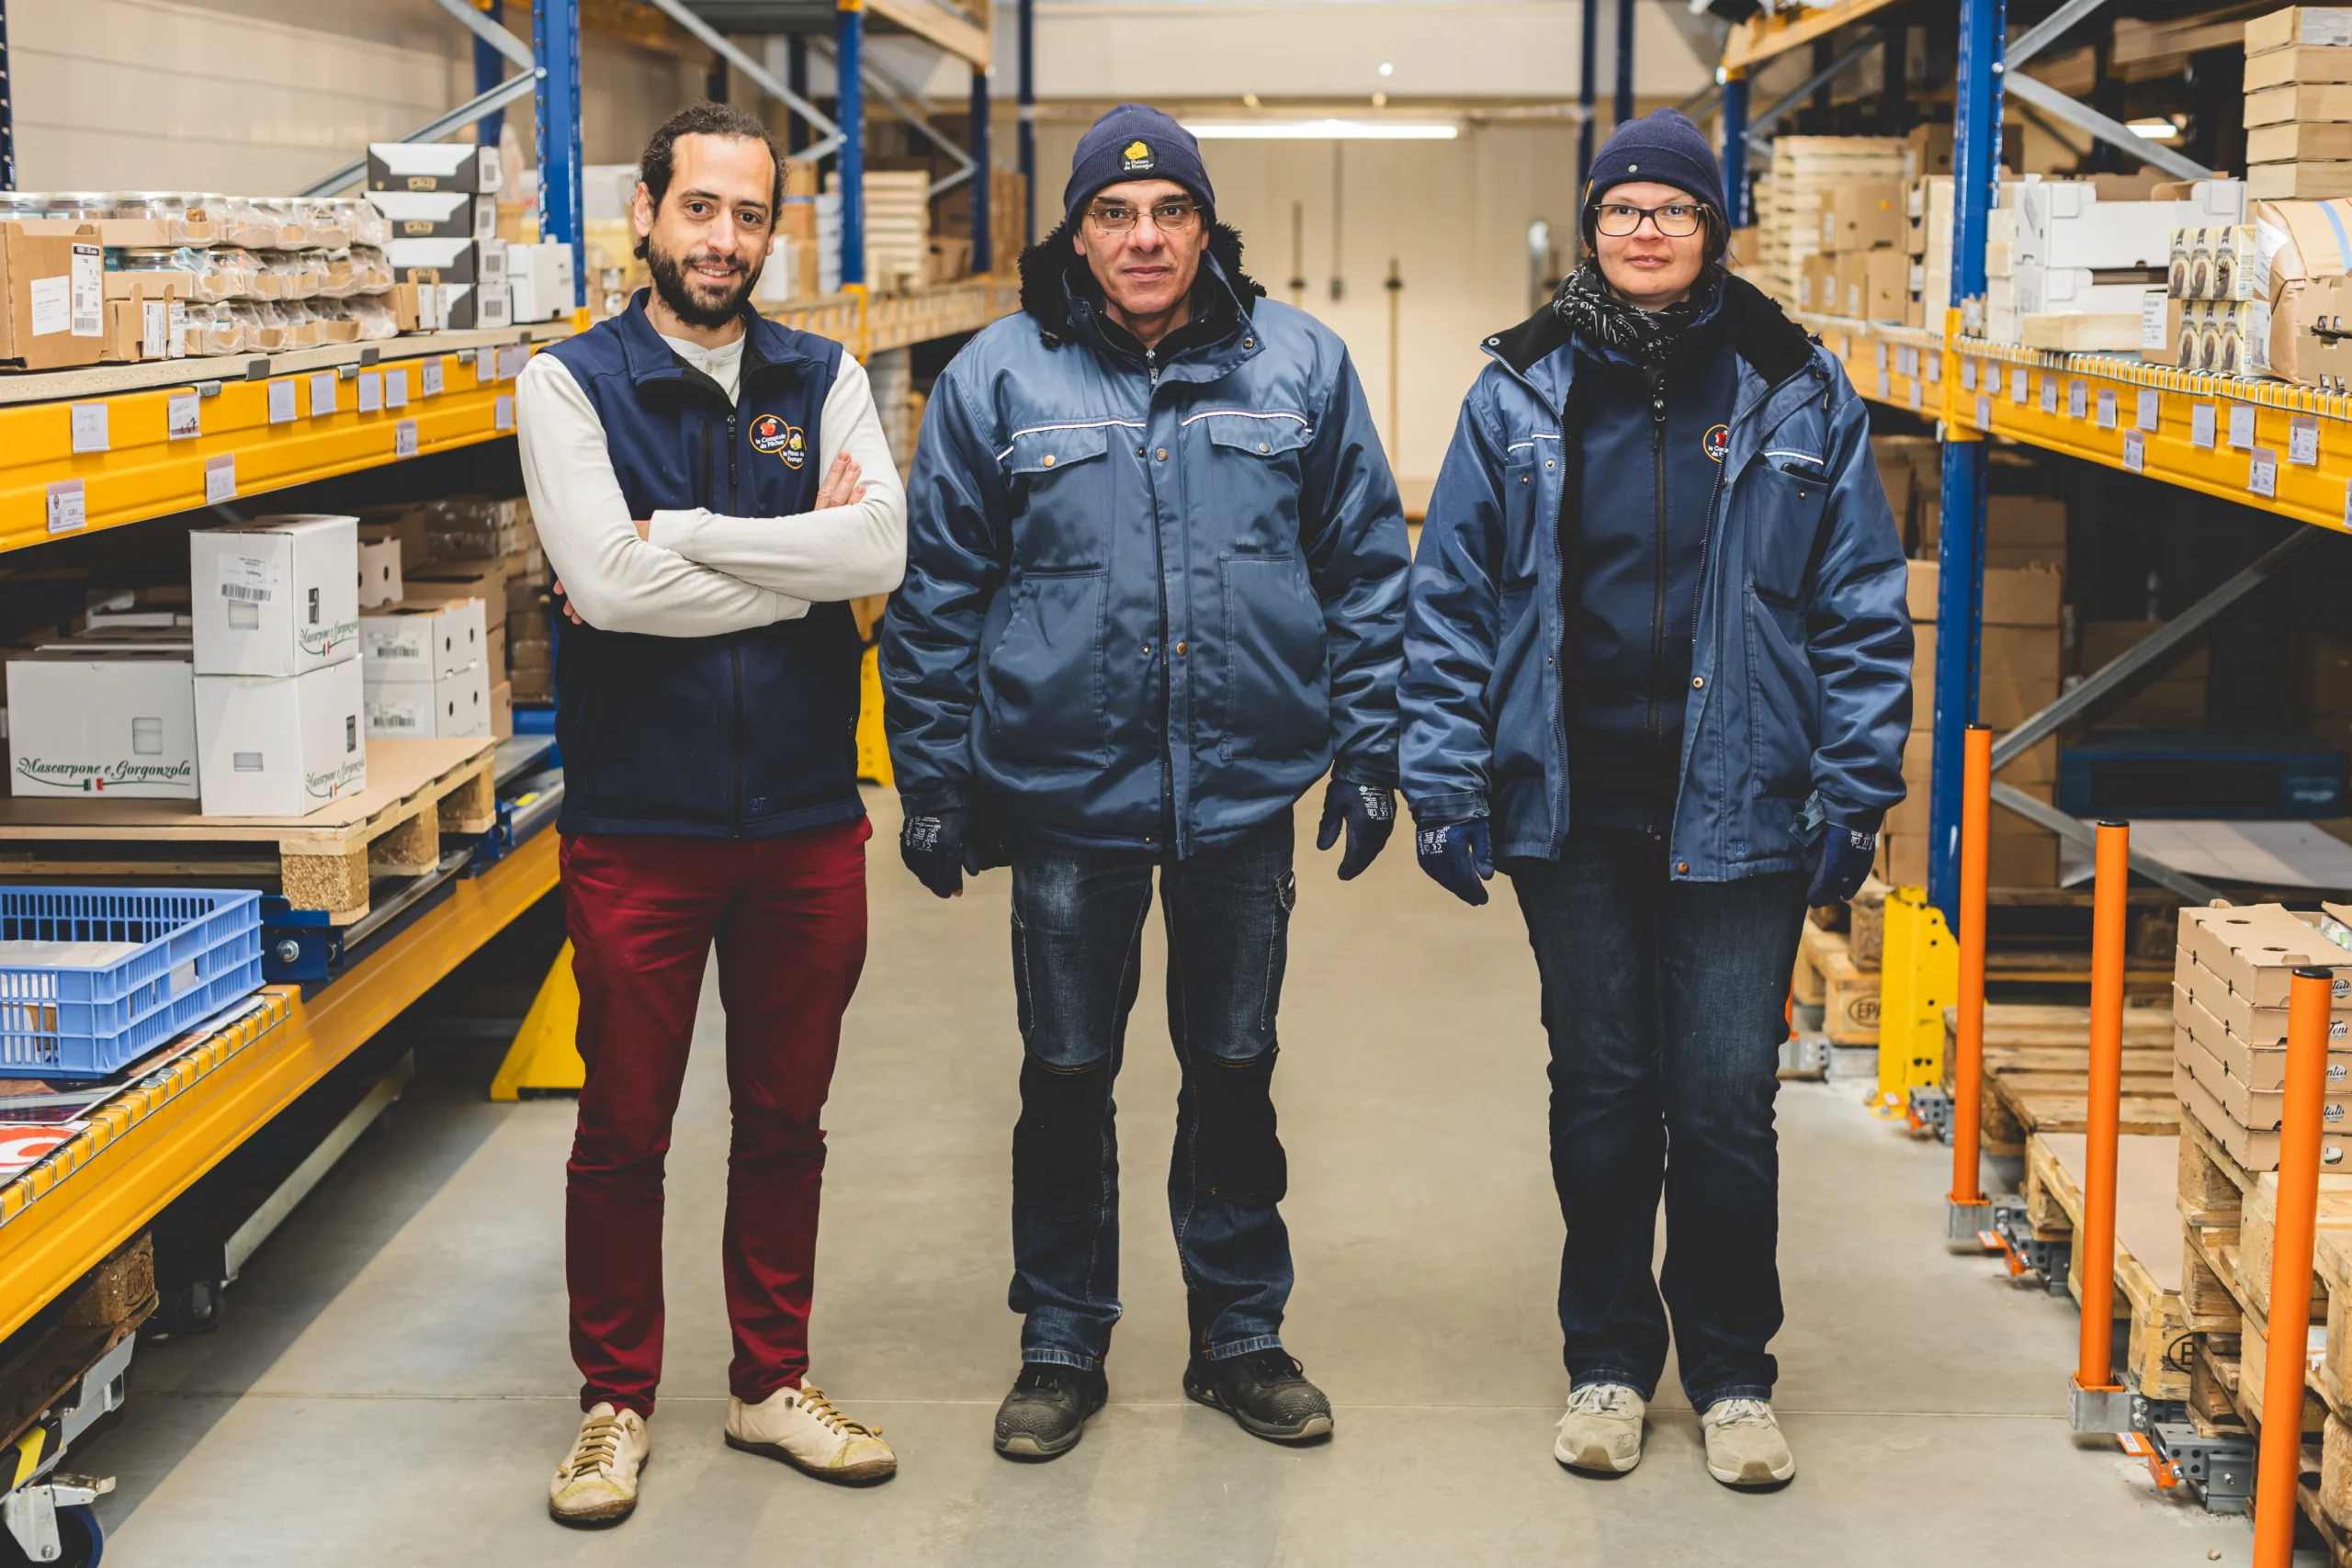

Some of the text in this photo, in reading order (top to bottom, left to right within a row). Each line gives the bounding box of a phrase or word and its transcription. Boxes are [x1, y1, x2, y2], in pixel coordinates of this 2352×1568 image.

[761, 434, 786, 444] Comptoir
[16, 757, 101, 778] Mascarpone
[111, 760, 191, 781] Gorgonzola
